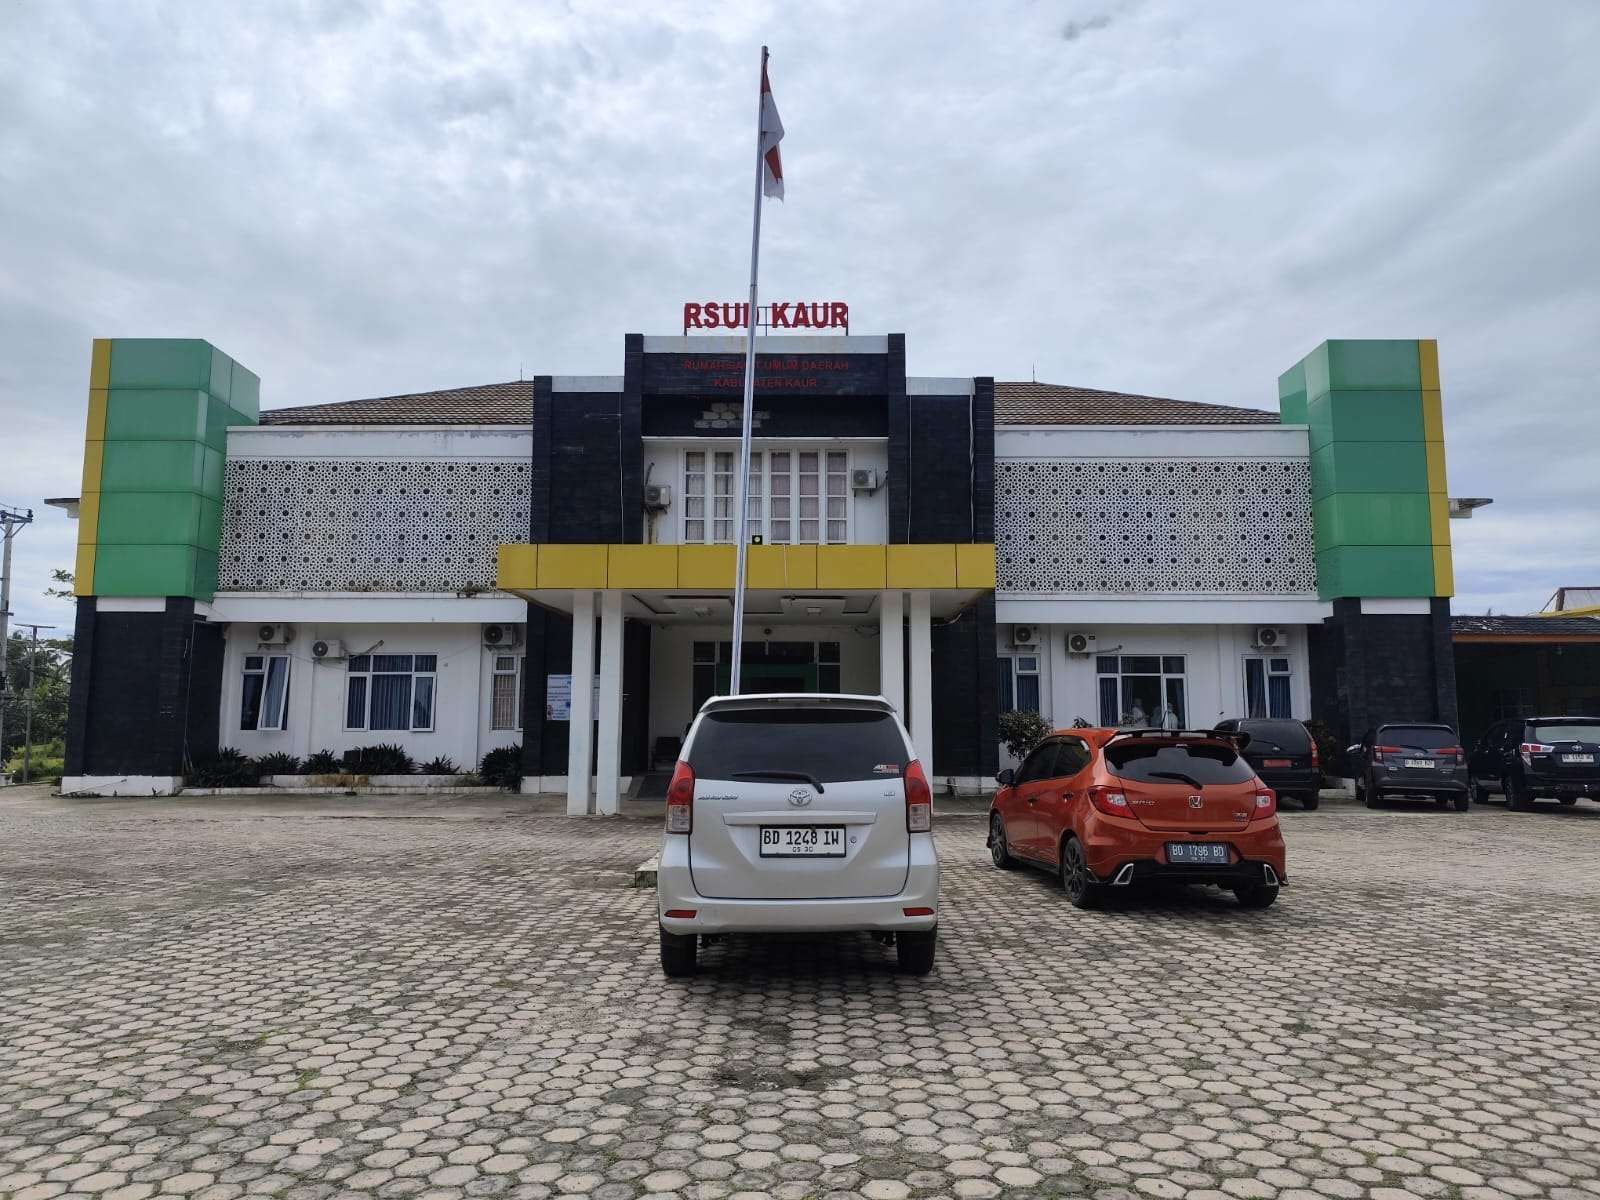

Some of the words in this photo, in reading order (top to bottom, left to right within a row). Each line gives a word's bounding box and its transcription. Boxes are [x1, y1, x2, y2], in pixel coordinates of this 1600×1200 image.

[772, 302, 849, 328] KAUR
[803, 361, 849, 370] DAERAH
[784, 379, 817, 387] KAUR
[763, 830, 780, 845] BD
[786, 830, 818, 845] 1248
[1172, 845, 1183, 856] BD
[1213, 846, 1224, 857] BD
